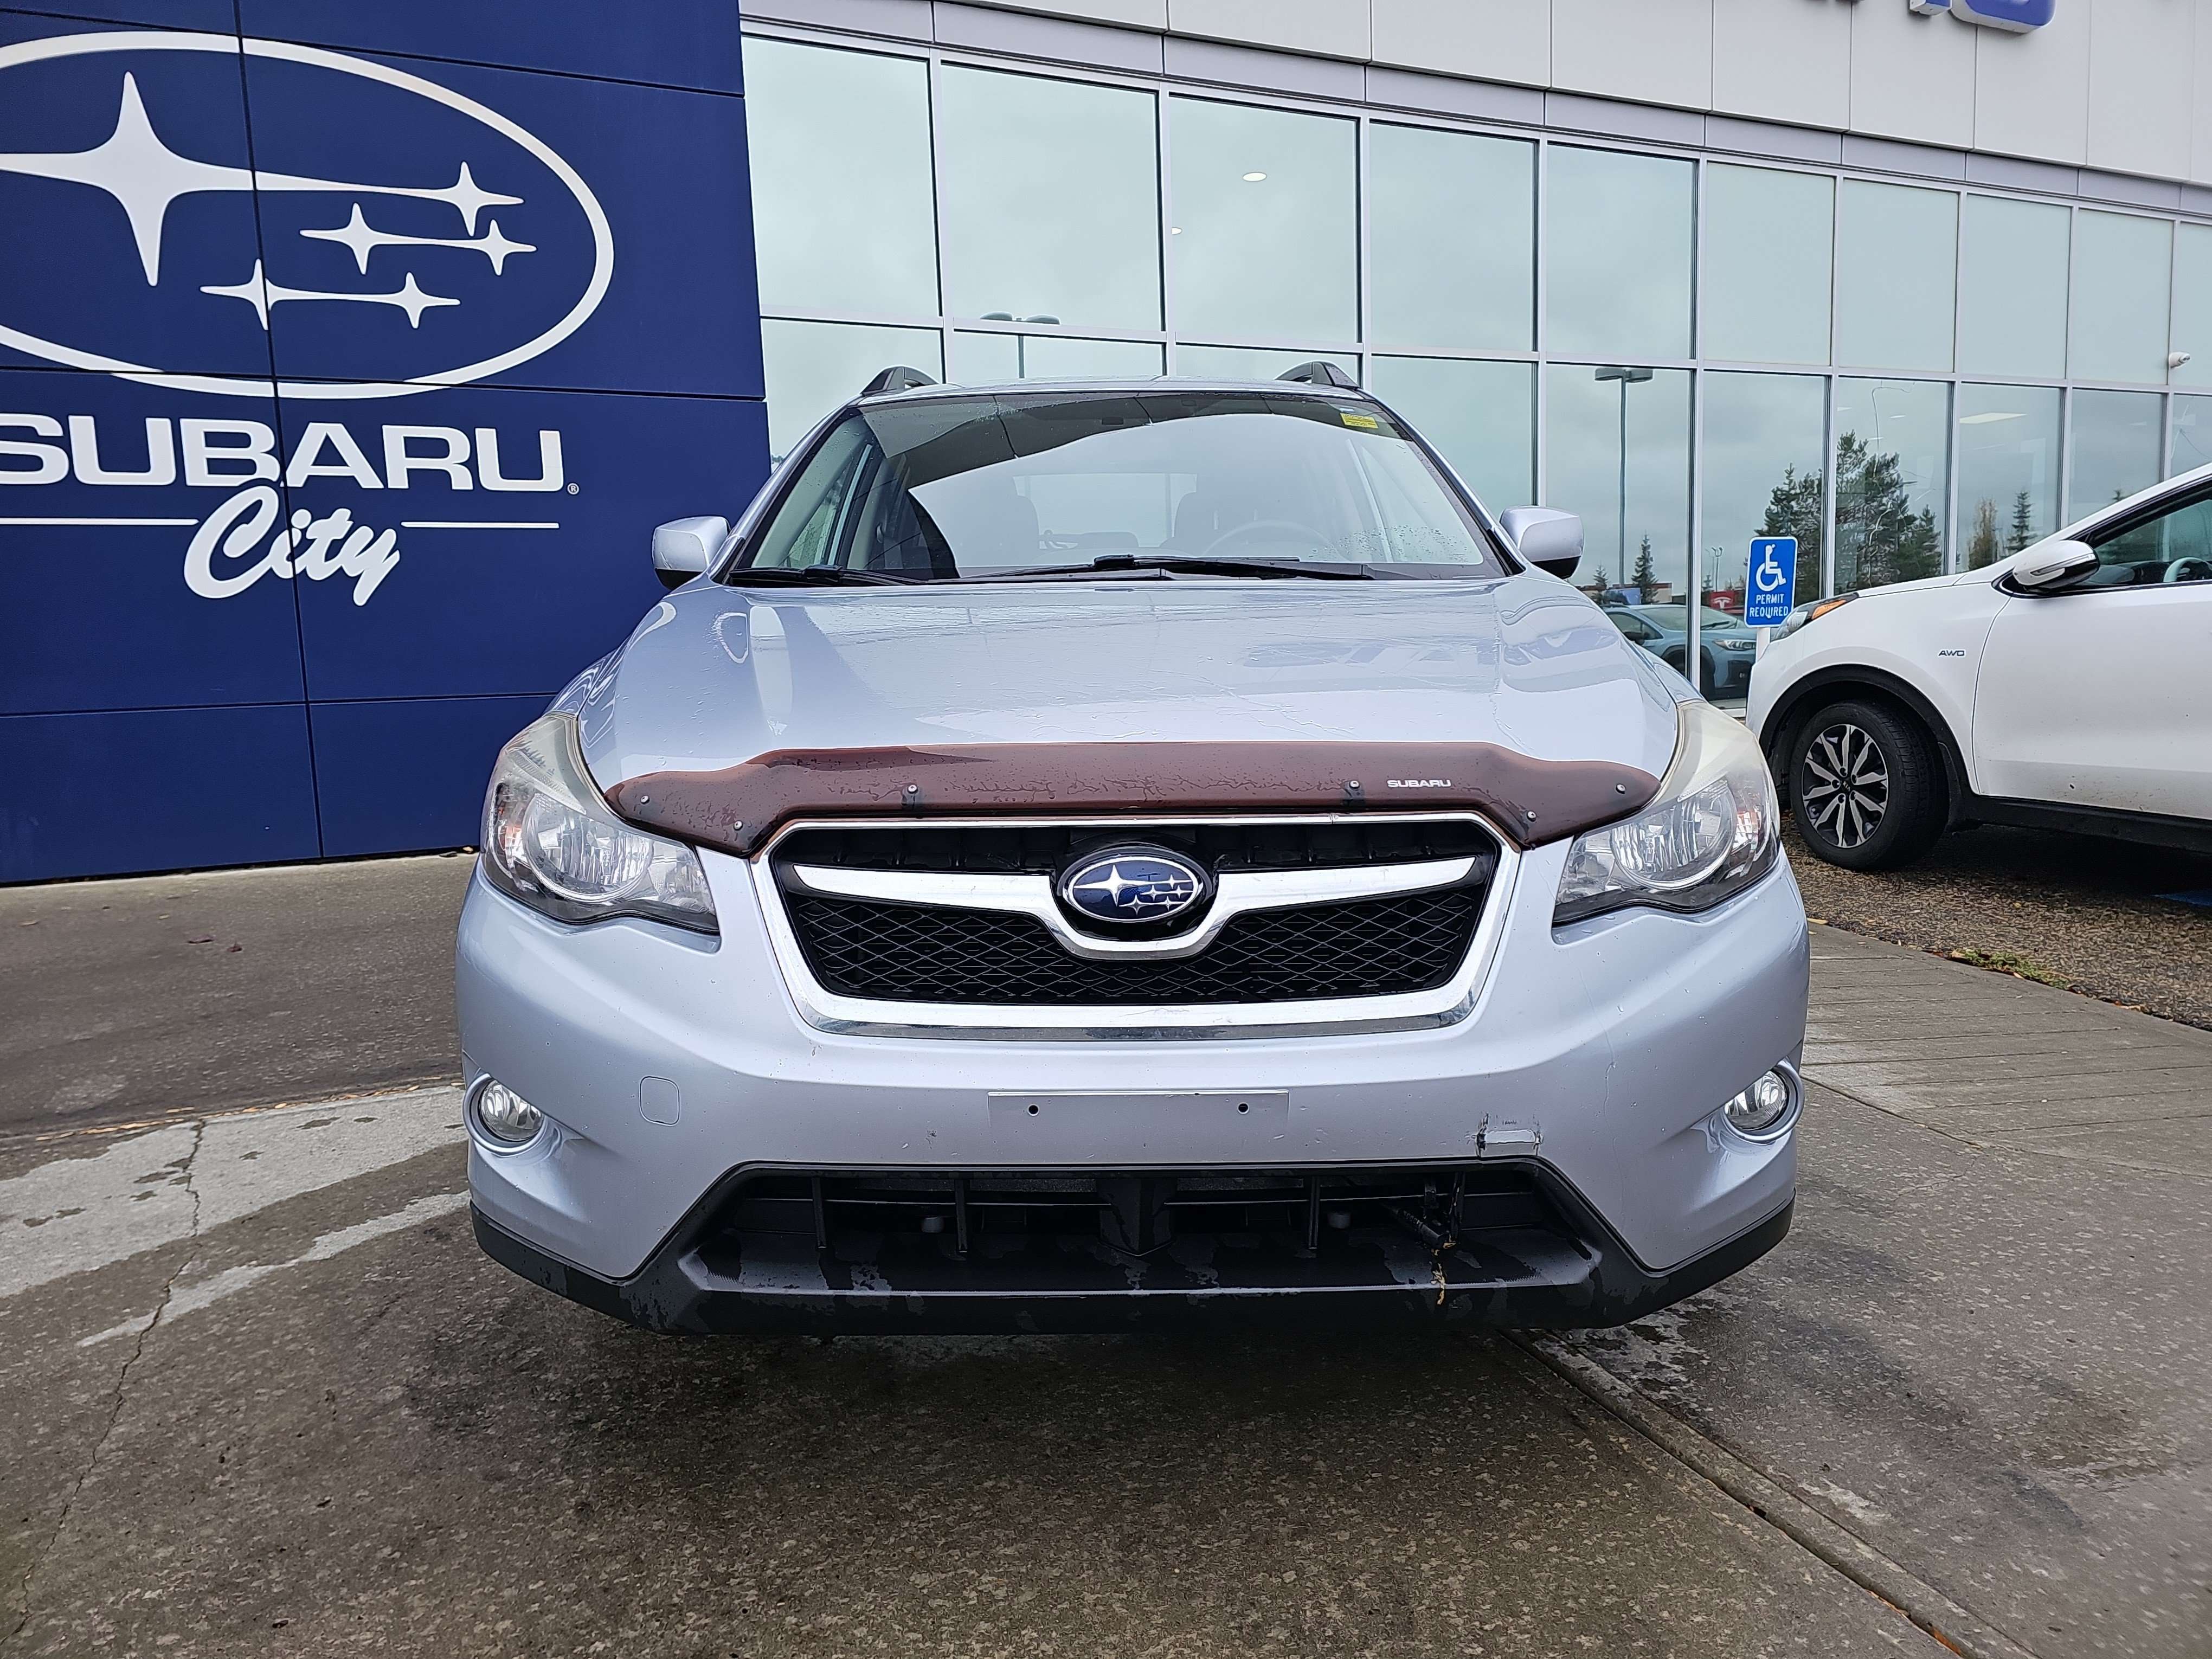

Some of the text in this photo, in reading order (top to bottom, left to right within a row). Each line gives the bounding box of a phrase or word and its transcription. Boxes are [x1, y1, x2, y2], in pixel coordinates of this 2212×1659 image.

[0, 413, 564, 492] SUBARU
[184, 485, 400, 606] City
[1749, 606, 1789, 618] REQUIRED
[1756, 594, 1784, 605] PERMIT
